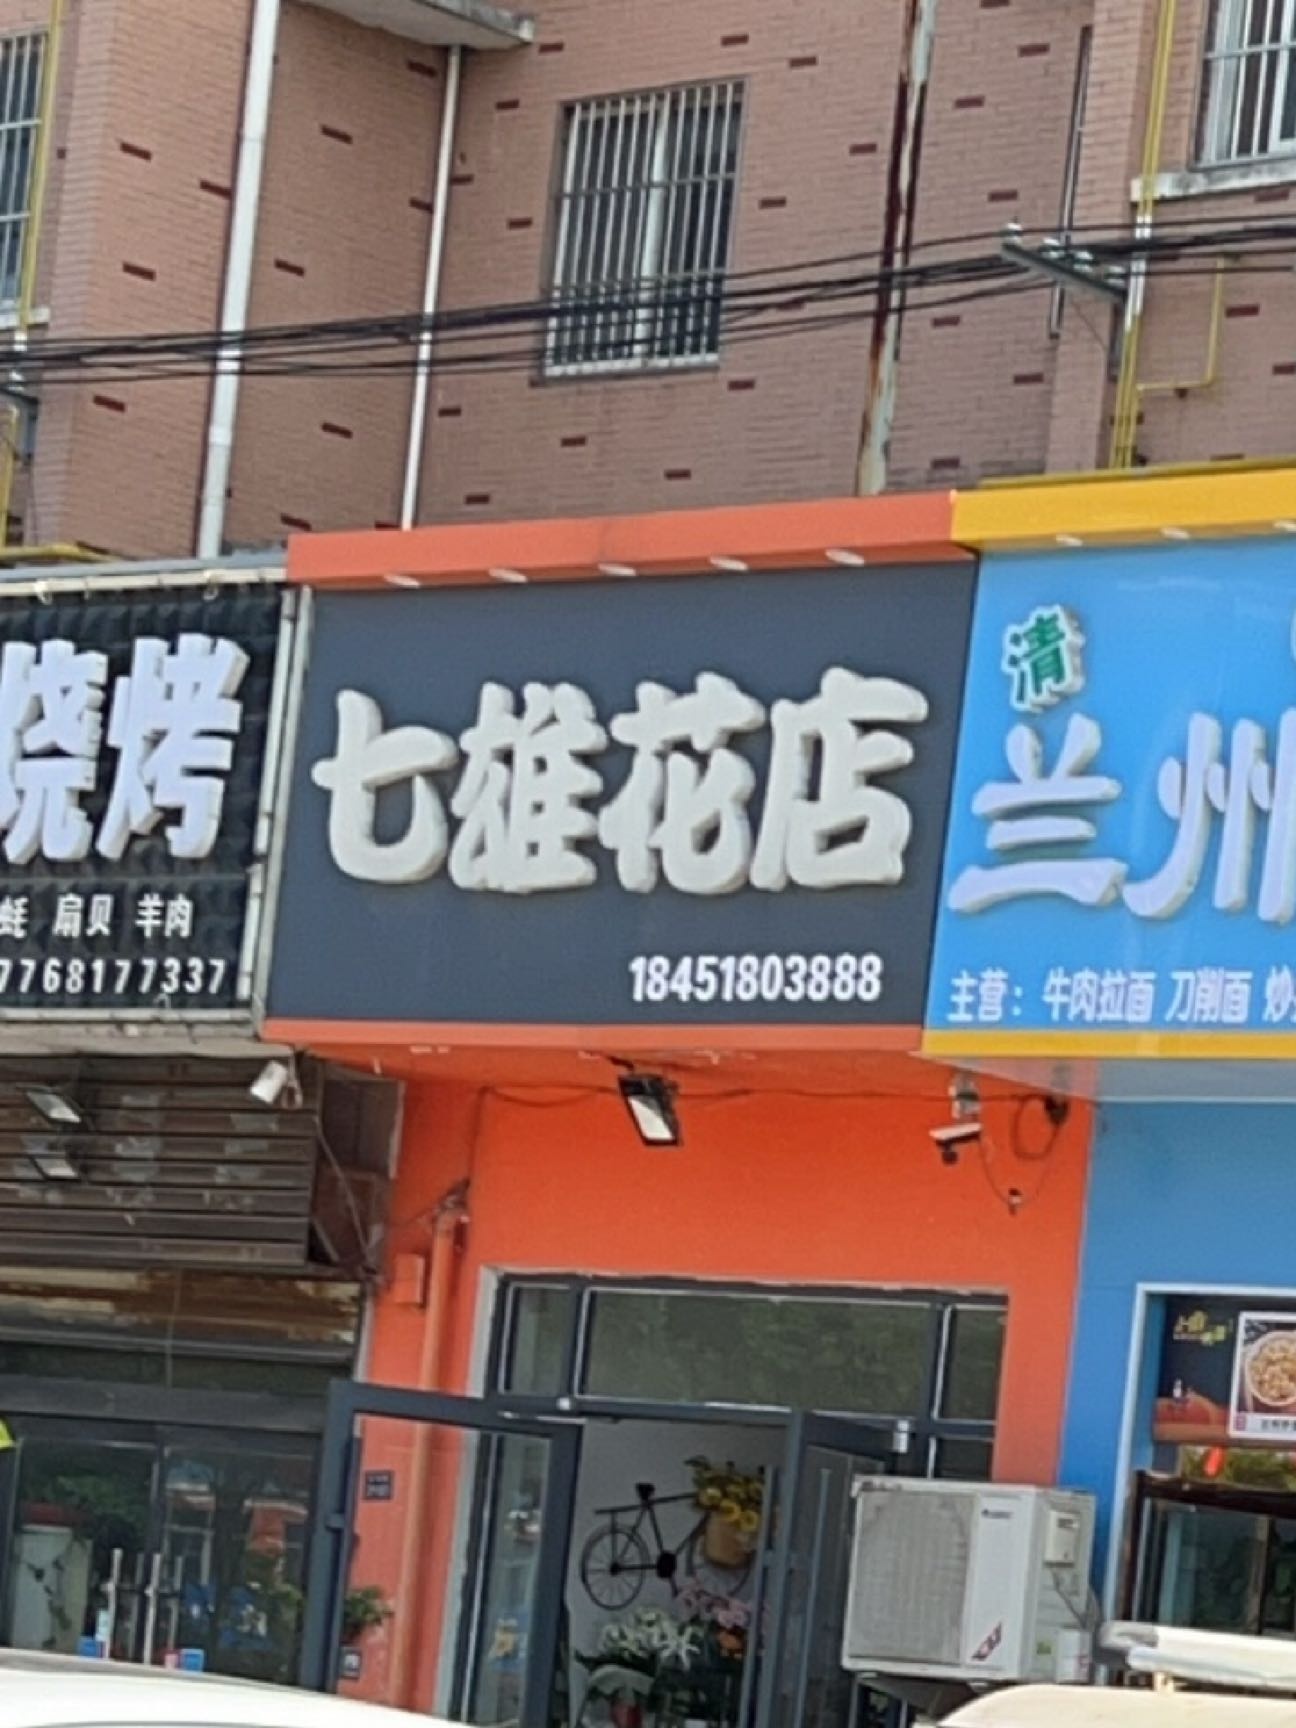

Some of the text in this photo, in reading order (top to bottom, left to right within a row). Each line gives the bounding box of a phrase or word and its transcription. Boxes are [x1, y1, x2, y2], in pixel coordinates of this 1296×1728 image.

[1003, 606, 1077, 709] 清
[0, 632, 250, 866] 烧烤
[52, 892, 114, 938] 扇贝
[134, 892, 194, 938] 羊肉
[629, 953, 883, 1003] 18451803888
[1042, 966, 1157, 1023] 牛肉拉面
[1164, 966, 1253, 1023] 刀削面
